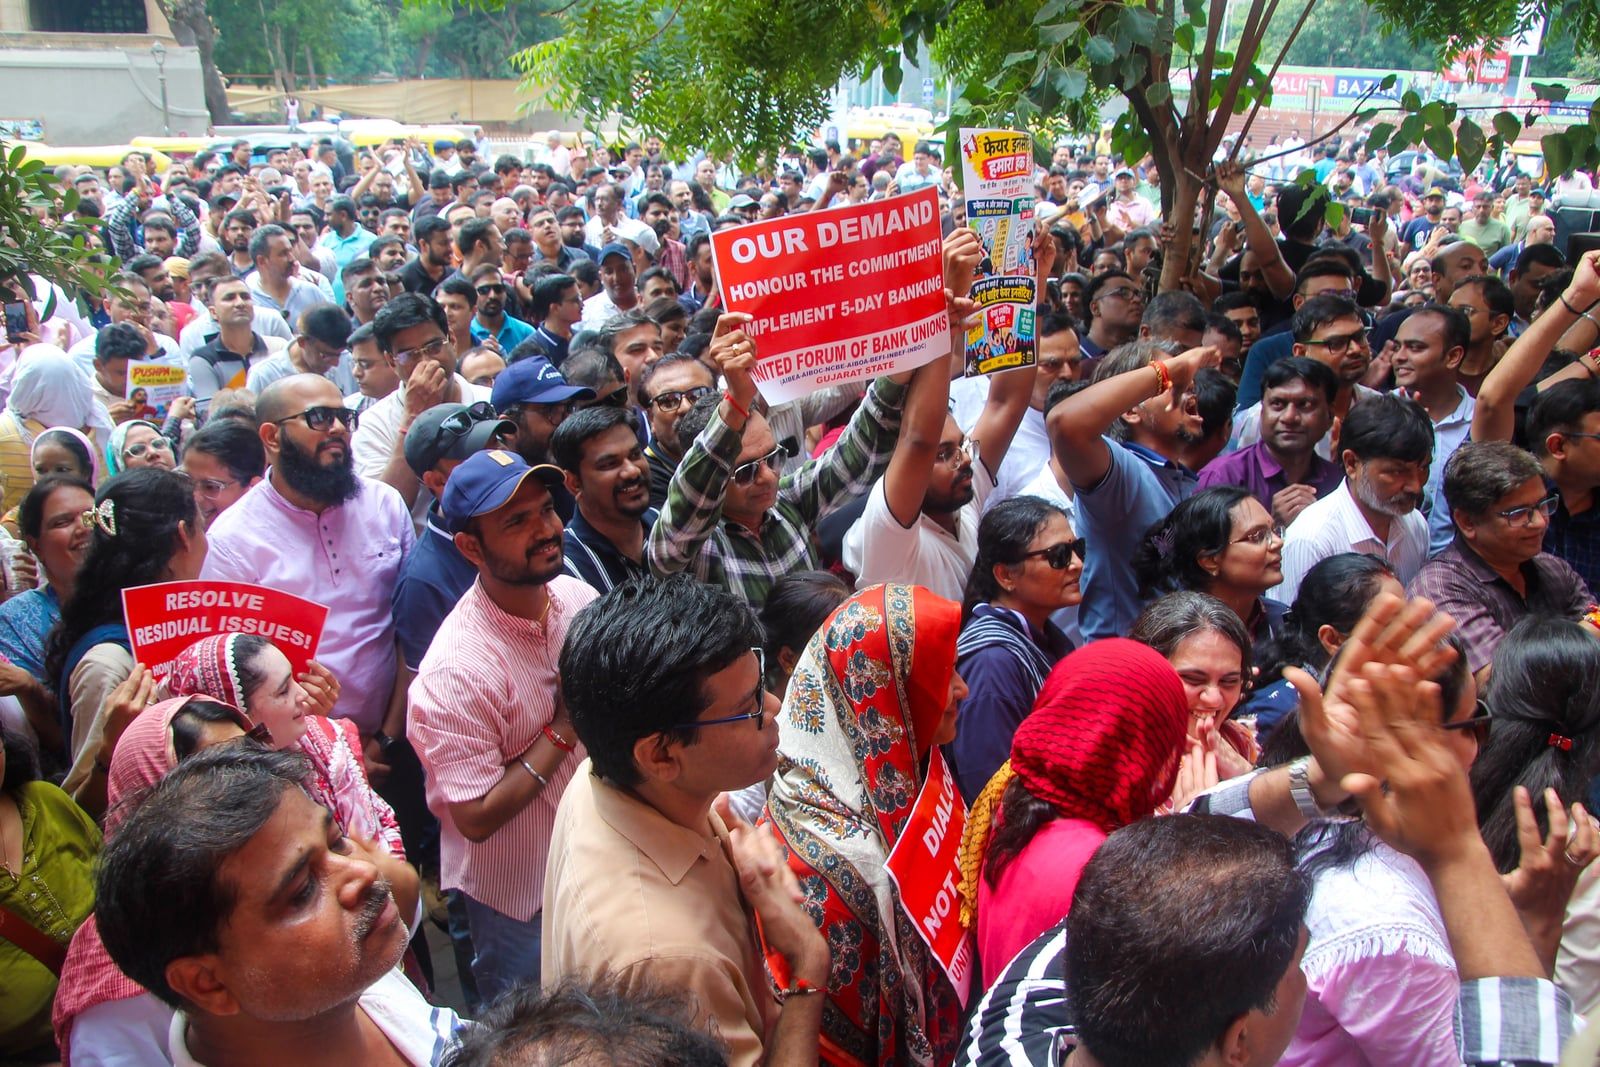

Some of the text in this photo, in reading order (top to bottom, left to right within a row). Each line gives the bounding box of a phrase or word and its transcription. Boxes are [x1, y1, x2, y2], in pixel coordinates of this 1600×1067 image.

[1272, 78, 1328, 93] PALIA
[731, 199, 933, 264] OUR DEMAND
[729, 237, 940, 302] HONOUR THE COMMITMENT!
[840, 293, 884, 317] 5-DAY
[888, 274, 942, 306] BANKING
[752, 358, 792, 384] NITED
[796, 344, 846, 371] FORUM
[850, 340, 871, 359] OF
[872, 328, 908, 354] BANK
[911, 314, 947, 343] UNIONS
[133, 367, 170, 378] PUSHPA
[816, 361, 895, 384] GUJARAT STATE
[166, 590, 265, 612] RESOLVE
[135, 615, 312, 650] RESIDUAL ISSUES!
[923, 869, 958, 940] NOT
